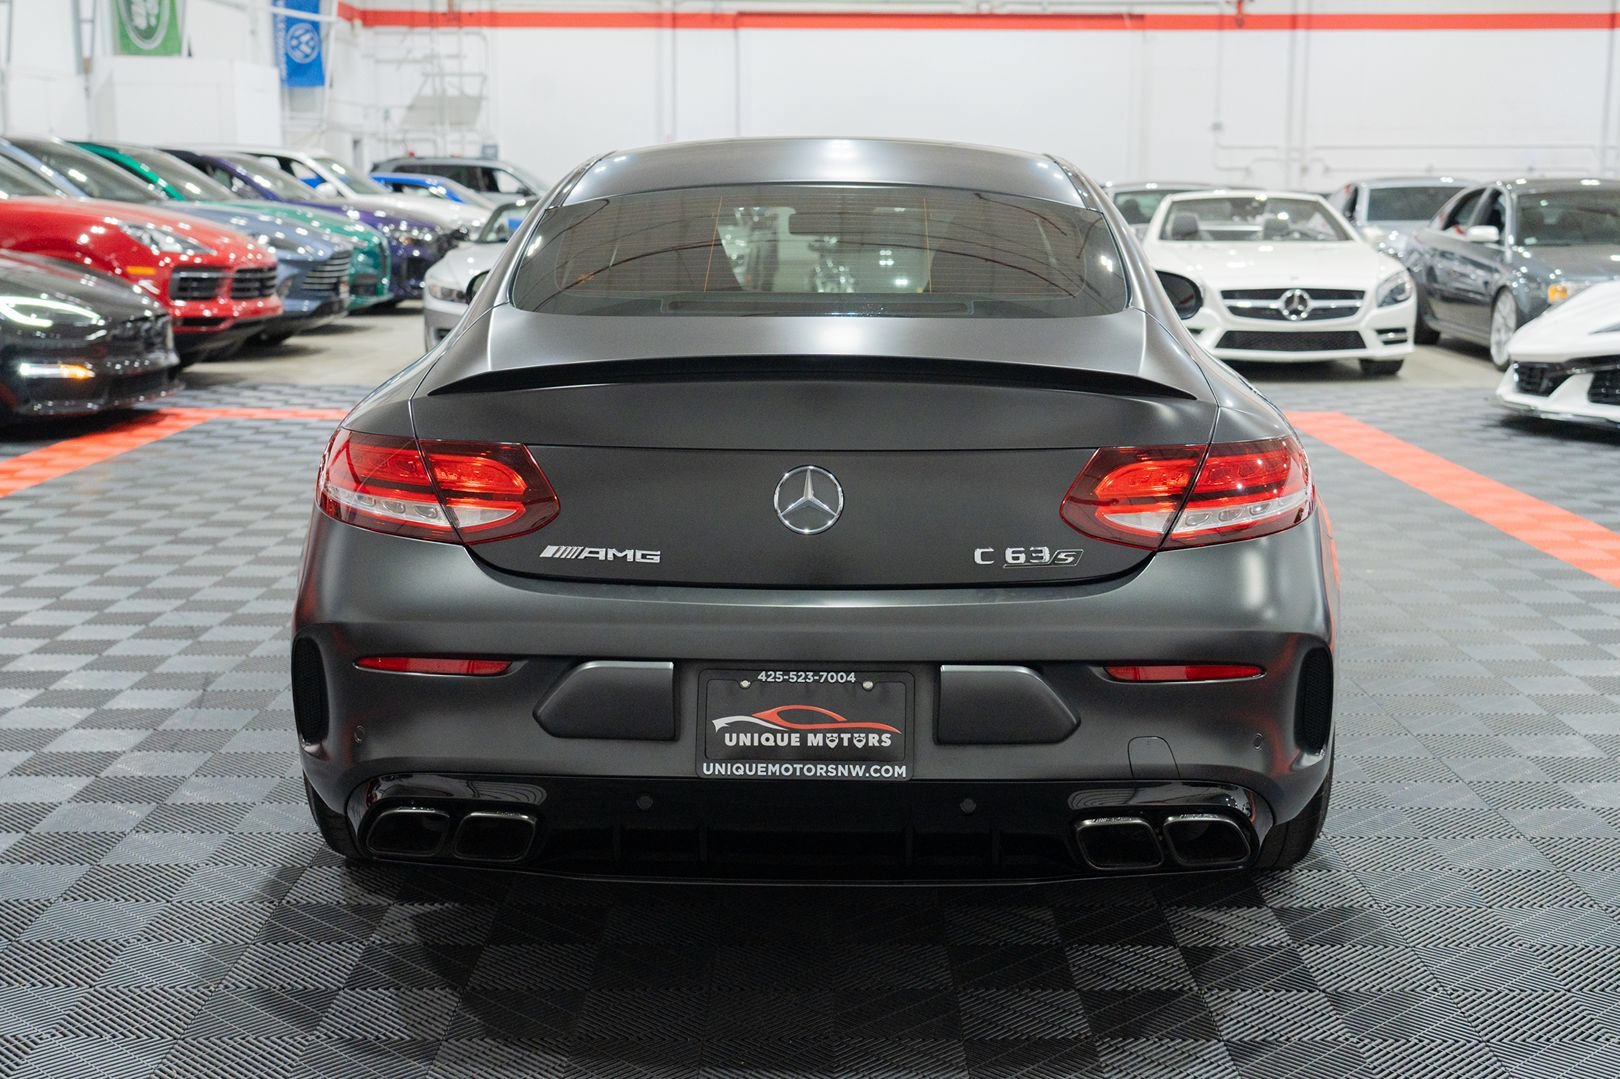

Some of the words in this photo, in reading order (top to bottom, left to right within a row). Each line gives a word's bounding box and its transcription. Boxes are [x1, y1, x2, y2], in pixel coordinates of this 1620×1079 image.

[577, 547, 661, 563] AMG
[974, 547, 995, 565] C
[757, 671, 857, 683] 425-523-7004
[724, 733, 801, 748] UNIQUE
[807, 733, 892, 749] MOTORS
[702, 762, 907, 778] UNIQUEMOTORSNW.COM
